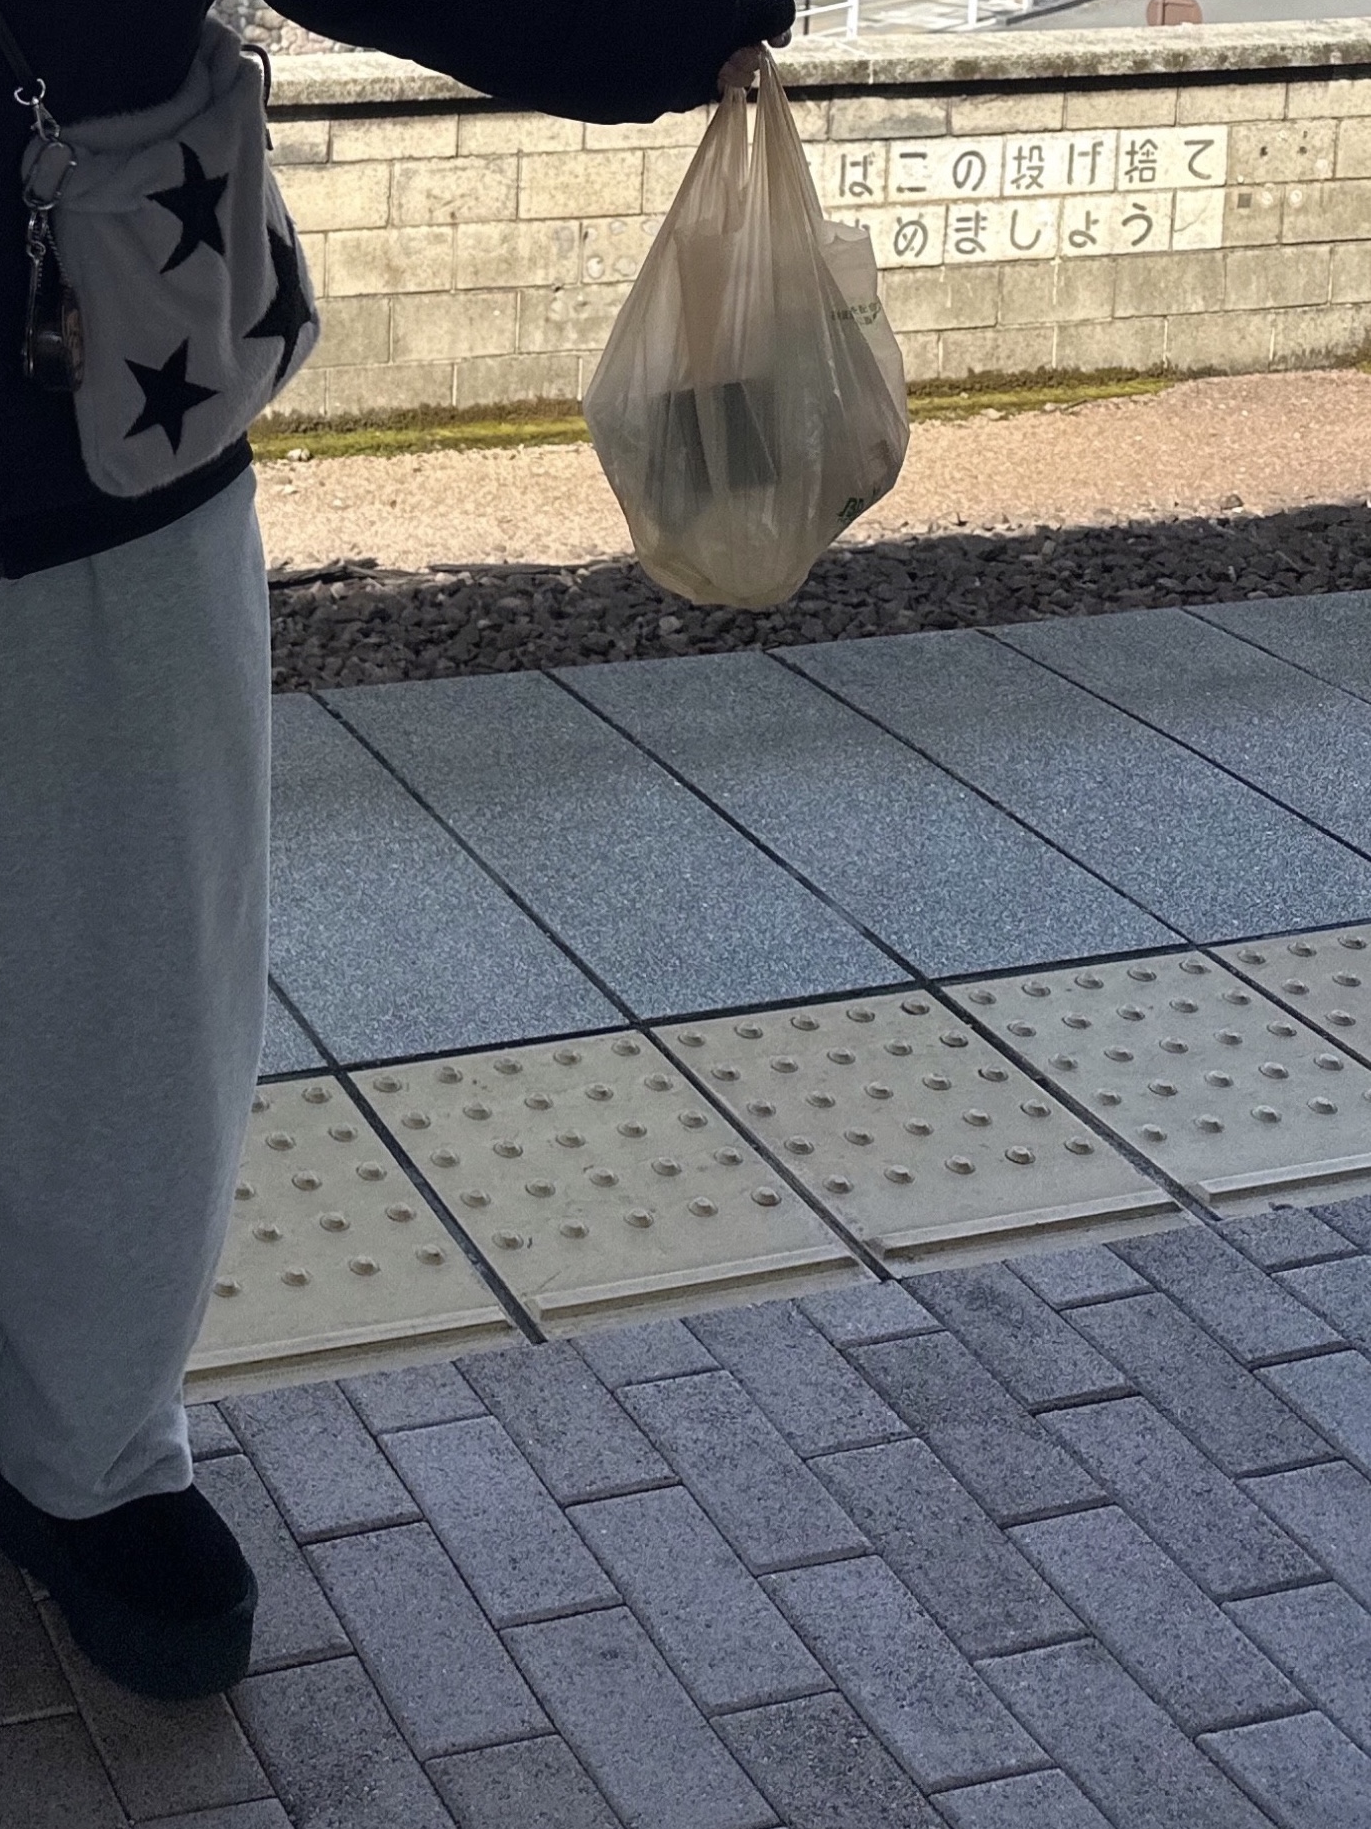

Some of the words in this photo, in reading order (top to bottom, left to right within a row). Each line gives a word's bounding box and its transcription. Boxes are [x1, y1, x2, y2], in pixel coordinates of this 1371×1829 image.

[807, 138, 1216, 198] ばこの投げ捨て
[839, 203, 1154, 258] めましょう
